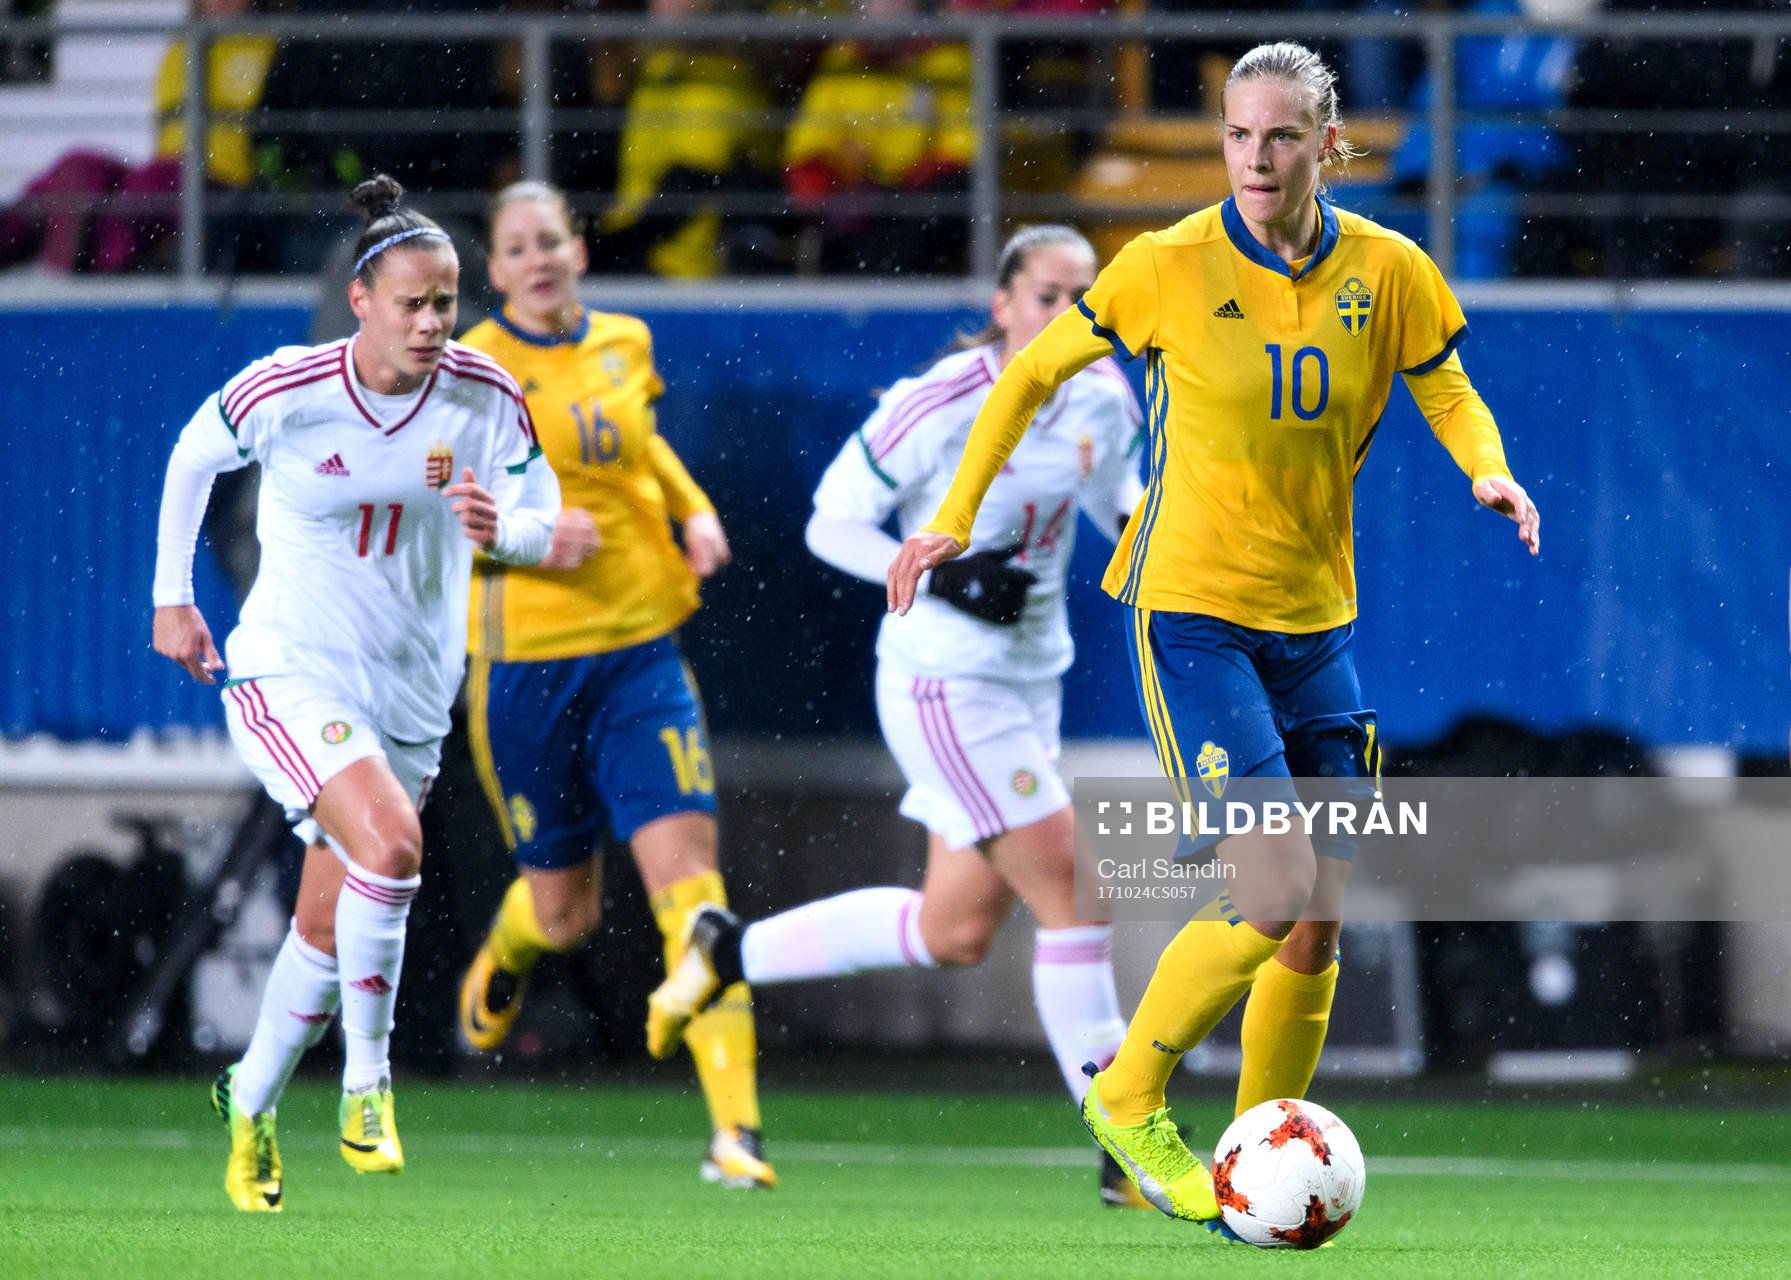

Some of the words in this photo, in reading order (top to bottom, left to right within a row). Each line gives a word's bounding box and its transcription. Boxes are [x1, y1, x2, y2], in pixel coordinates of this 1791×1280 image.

[1213, 310, 1245, 320] adidas
[1265, 344, 1329, 420] 10
[570, 401, 621, 465] 16
[358, 503, 403, 557] 11
[659, 726, 715, 795] 16
